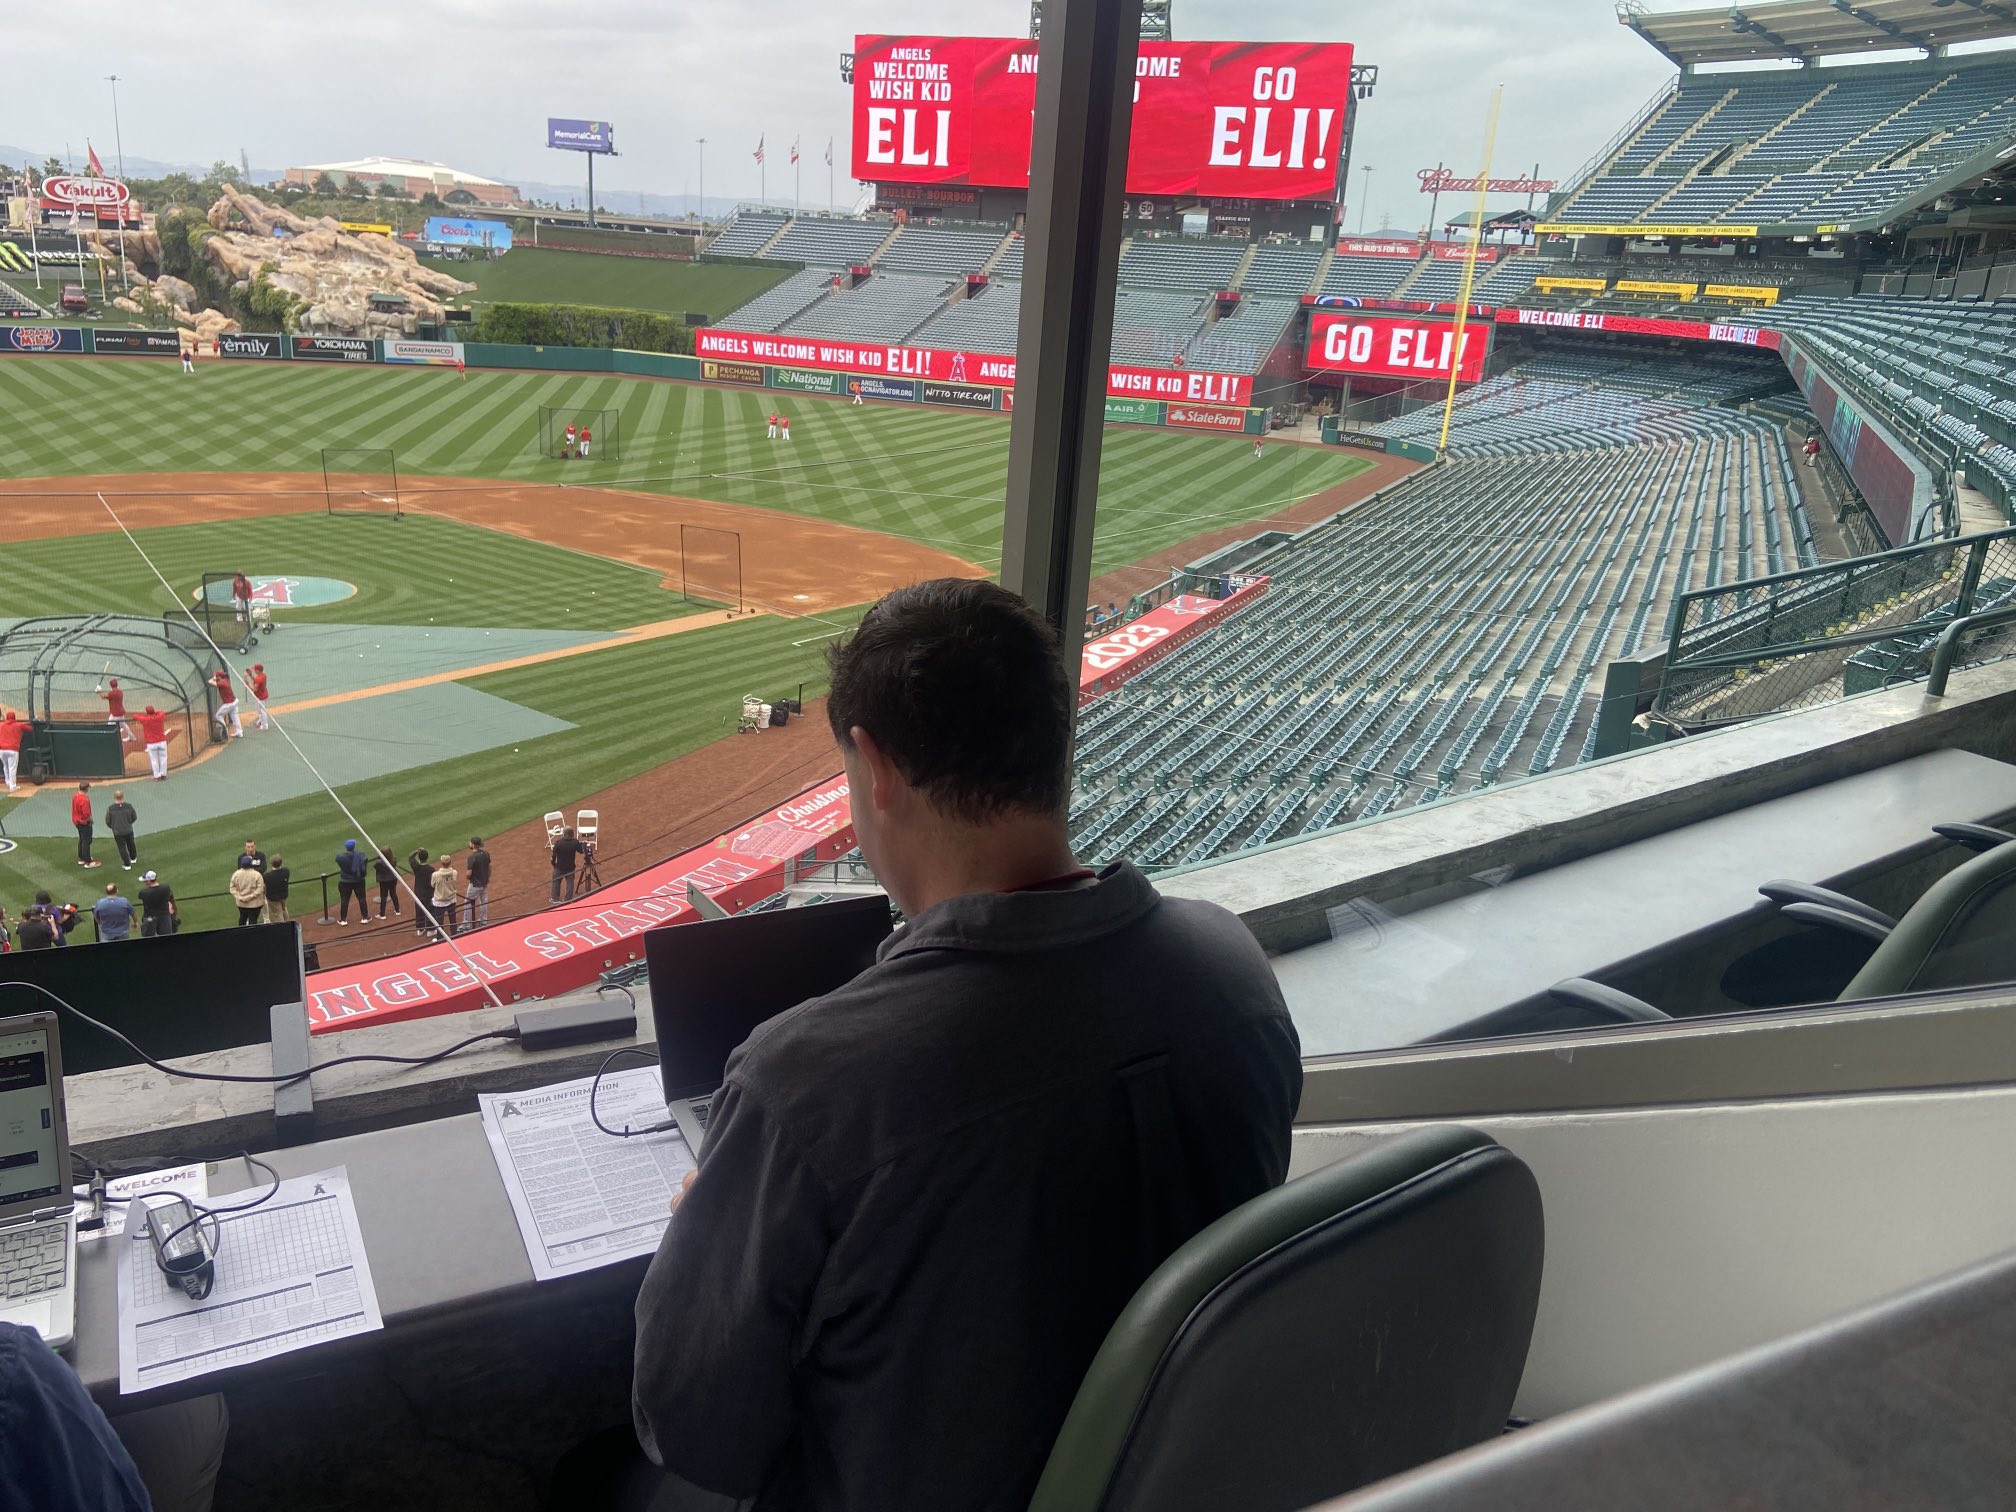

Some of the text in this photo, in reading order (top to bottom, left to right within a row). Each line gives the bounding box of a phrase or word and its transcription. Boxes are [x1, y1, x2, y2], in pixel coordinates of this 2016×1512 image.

[890, 47, 931, 61] ANGELS
[873, 62, 949, 81] WELCOME
[868, 80, 952, 102] WISH KID
[1252, 66, 1297, 101] GO
[866, 107, 952, 167] ELI
[1207, 105, 1336, 170] ELI!
[58, 183, 116, 199] Yakult
[926, 189, 976, 202] BOURBON
[440, 223, 470, 236] Coors
[1348, 243, 1363, 251] THIS
[1363, 244, 1382, 253] BUD'S
[1382, 245, 1395, 253] FOR
[1518, 309, 1604, 329] WELCOME ELI
[17, 326, 54, 338] Jersey
[1709, 324, 1748, 343] WELCOME
[313, 339, 367, 350] YOKOHAMA
[1324, 323, 1471, 372] GO ELI!
[343, 351, 368, 360] TIRES
[701, 335, 749, 354] ANGELS
[752, 341, 816, 361] WELCOME
[819, 347, 855, 364] WISH
[858, 351, 882, 367] KID
[886, 347, 932, 375] ELI!
[719, 366, 760, 377] PECHANGA
[789, 371, 833, 387] National
[860, 379, 885, 389] ANGELS.
[860, 385, 913, 398] OCNAVIGATOR.ORG
[1111, 373, 1240, 403] WISH KID ELI!
[925, 387, 992, 403] NITTO TIRE.COM
[1113, 405, 1134, 413] AIR
[1339, 434, 1385, 449] HeGetsUs.com
[1082, 624, 1170, 670] 2023
[776, 780, 849, 823] Christma
[524, 857, 760, 961] STADIUM
[520, 1095, 552, 1108] MEDIA
[113, 1169, 198, 1192] WELCOME
